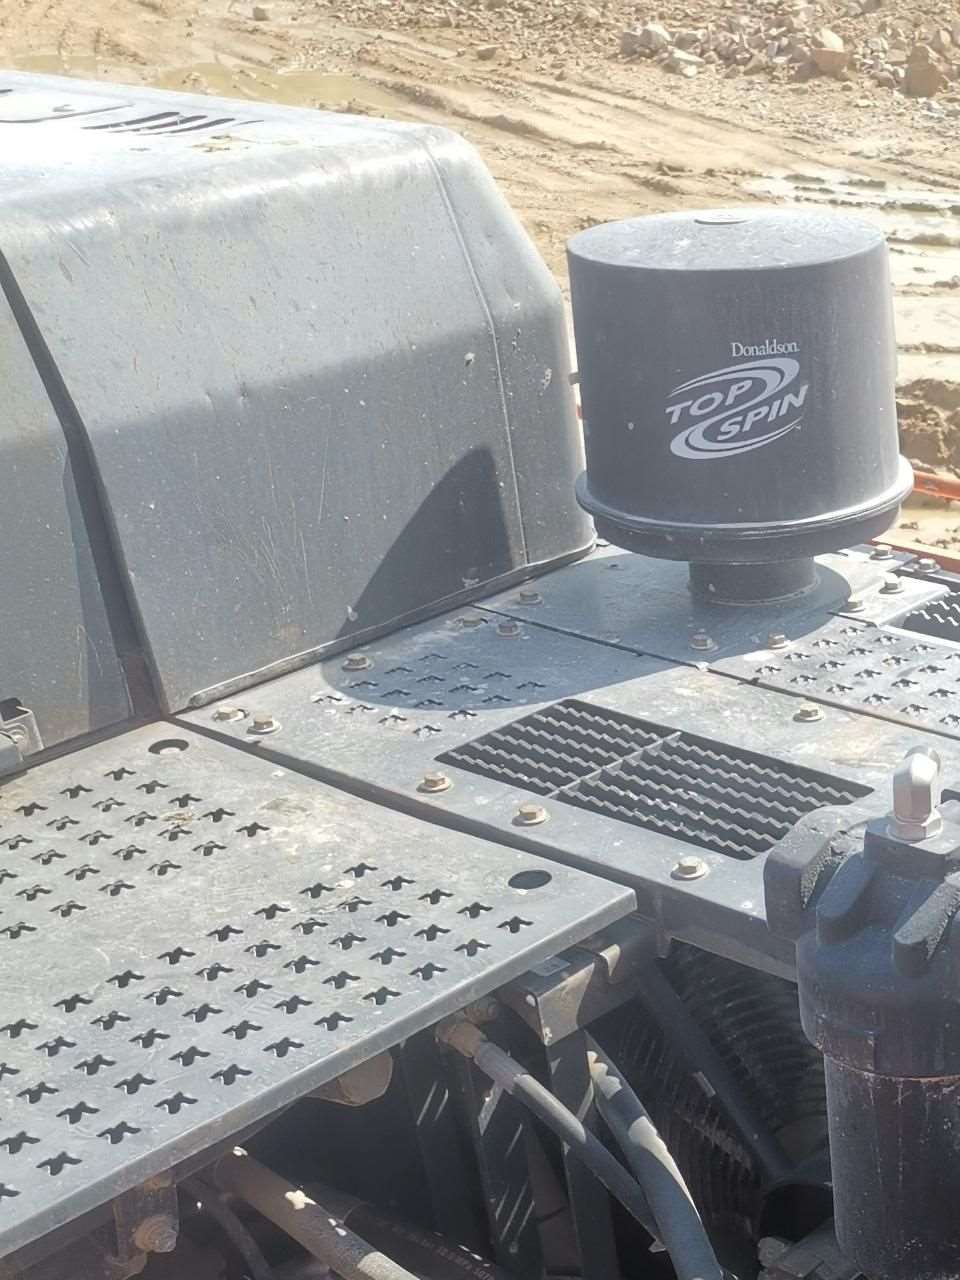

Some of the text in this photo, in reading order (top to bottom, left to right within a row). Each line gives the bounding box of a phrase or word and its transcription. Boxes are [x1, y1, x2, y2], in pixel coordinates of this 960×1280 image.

[731, 339, 798, 358] Donaldson
[665, 379, 753, 425] TOP
[716, 383, 810, 442] SPIN
